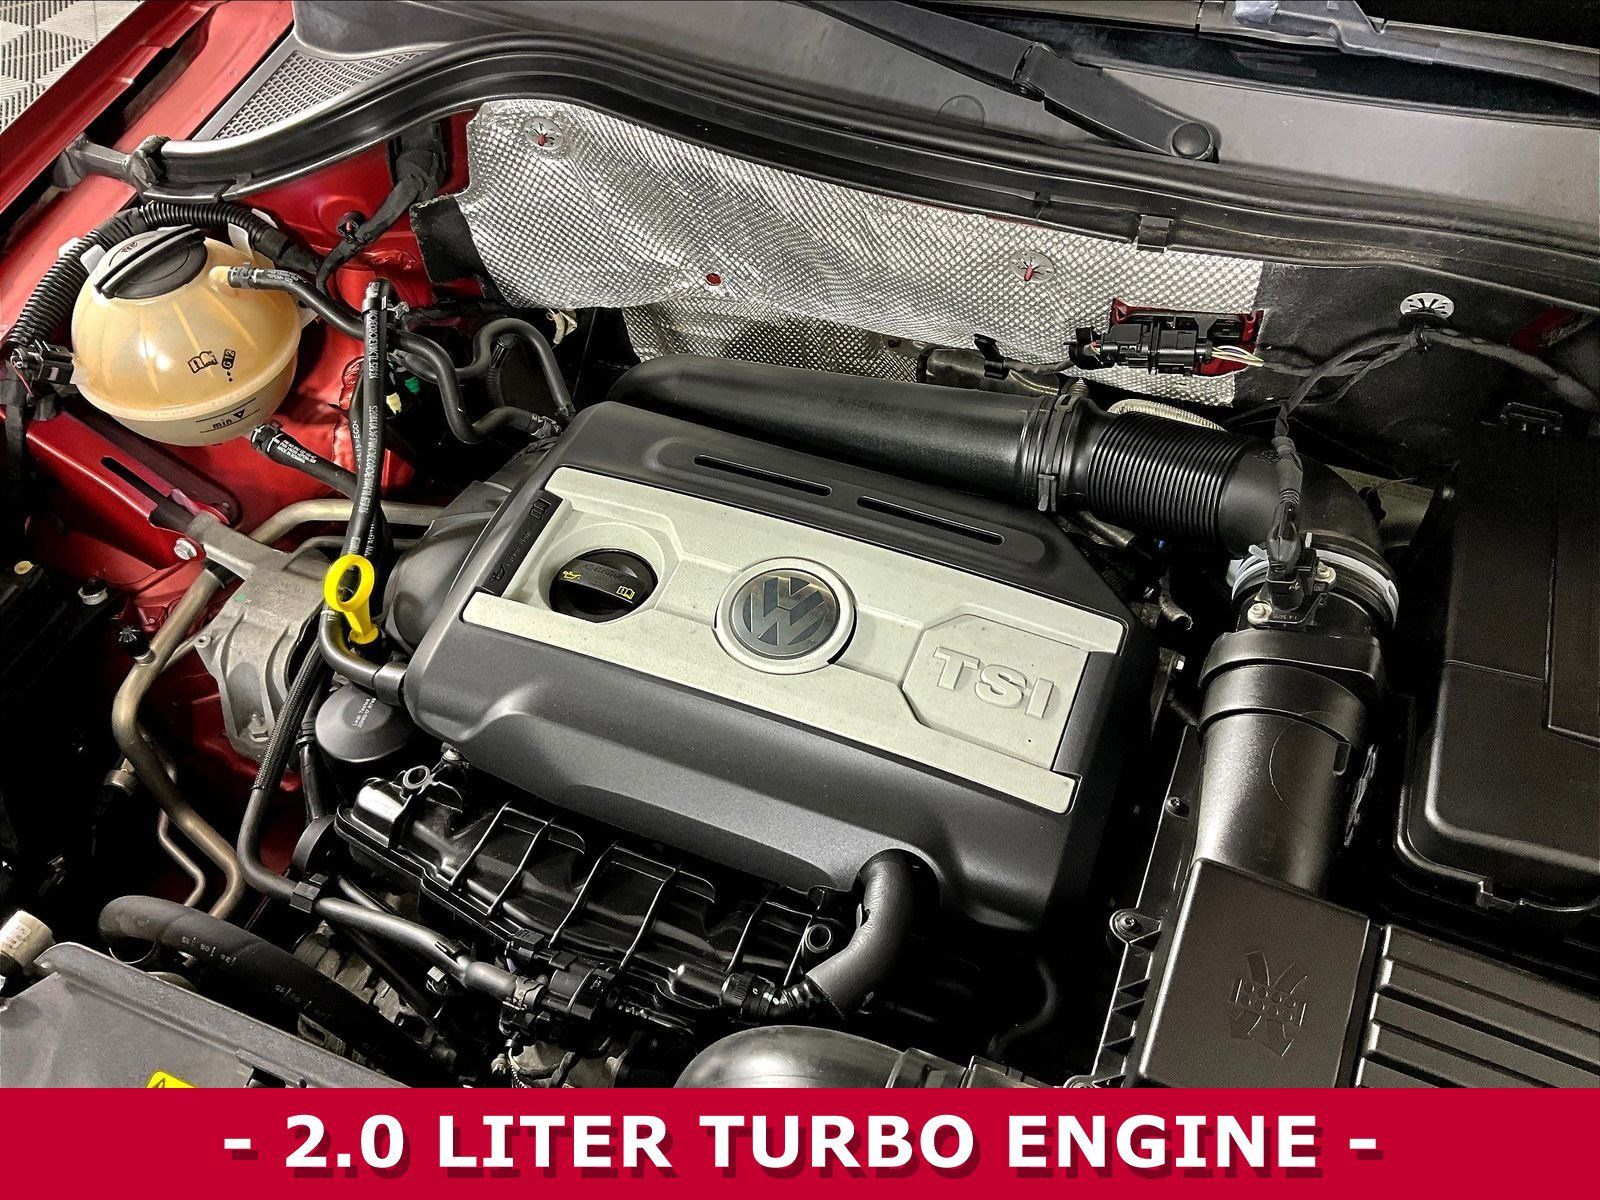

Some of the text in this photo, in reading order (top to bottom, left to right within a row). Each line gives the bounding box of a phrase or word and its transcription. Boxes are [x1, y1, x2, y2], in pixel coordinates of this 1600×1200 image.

[222, 349, 236, 370] G12
[212, 418, 233, 430] min
[734, 570, 838, 658] VW
[933, 646, 1058, 720] TSI
